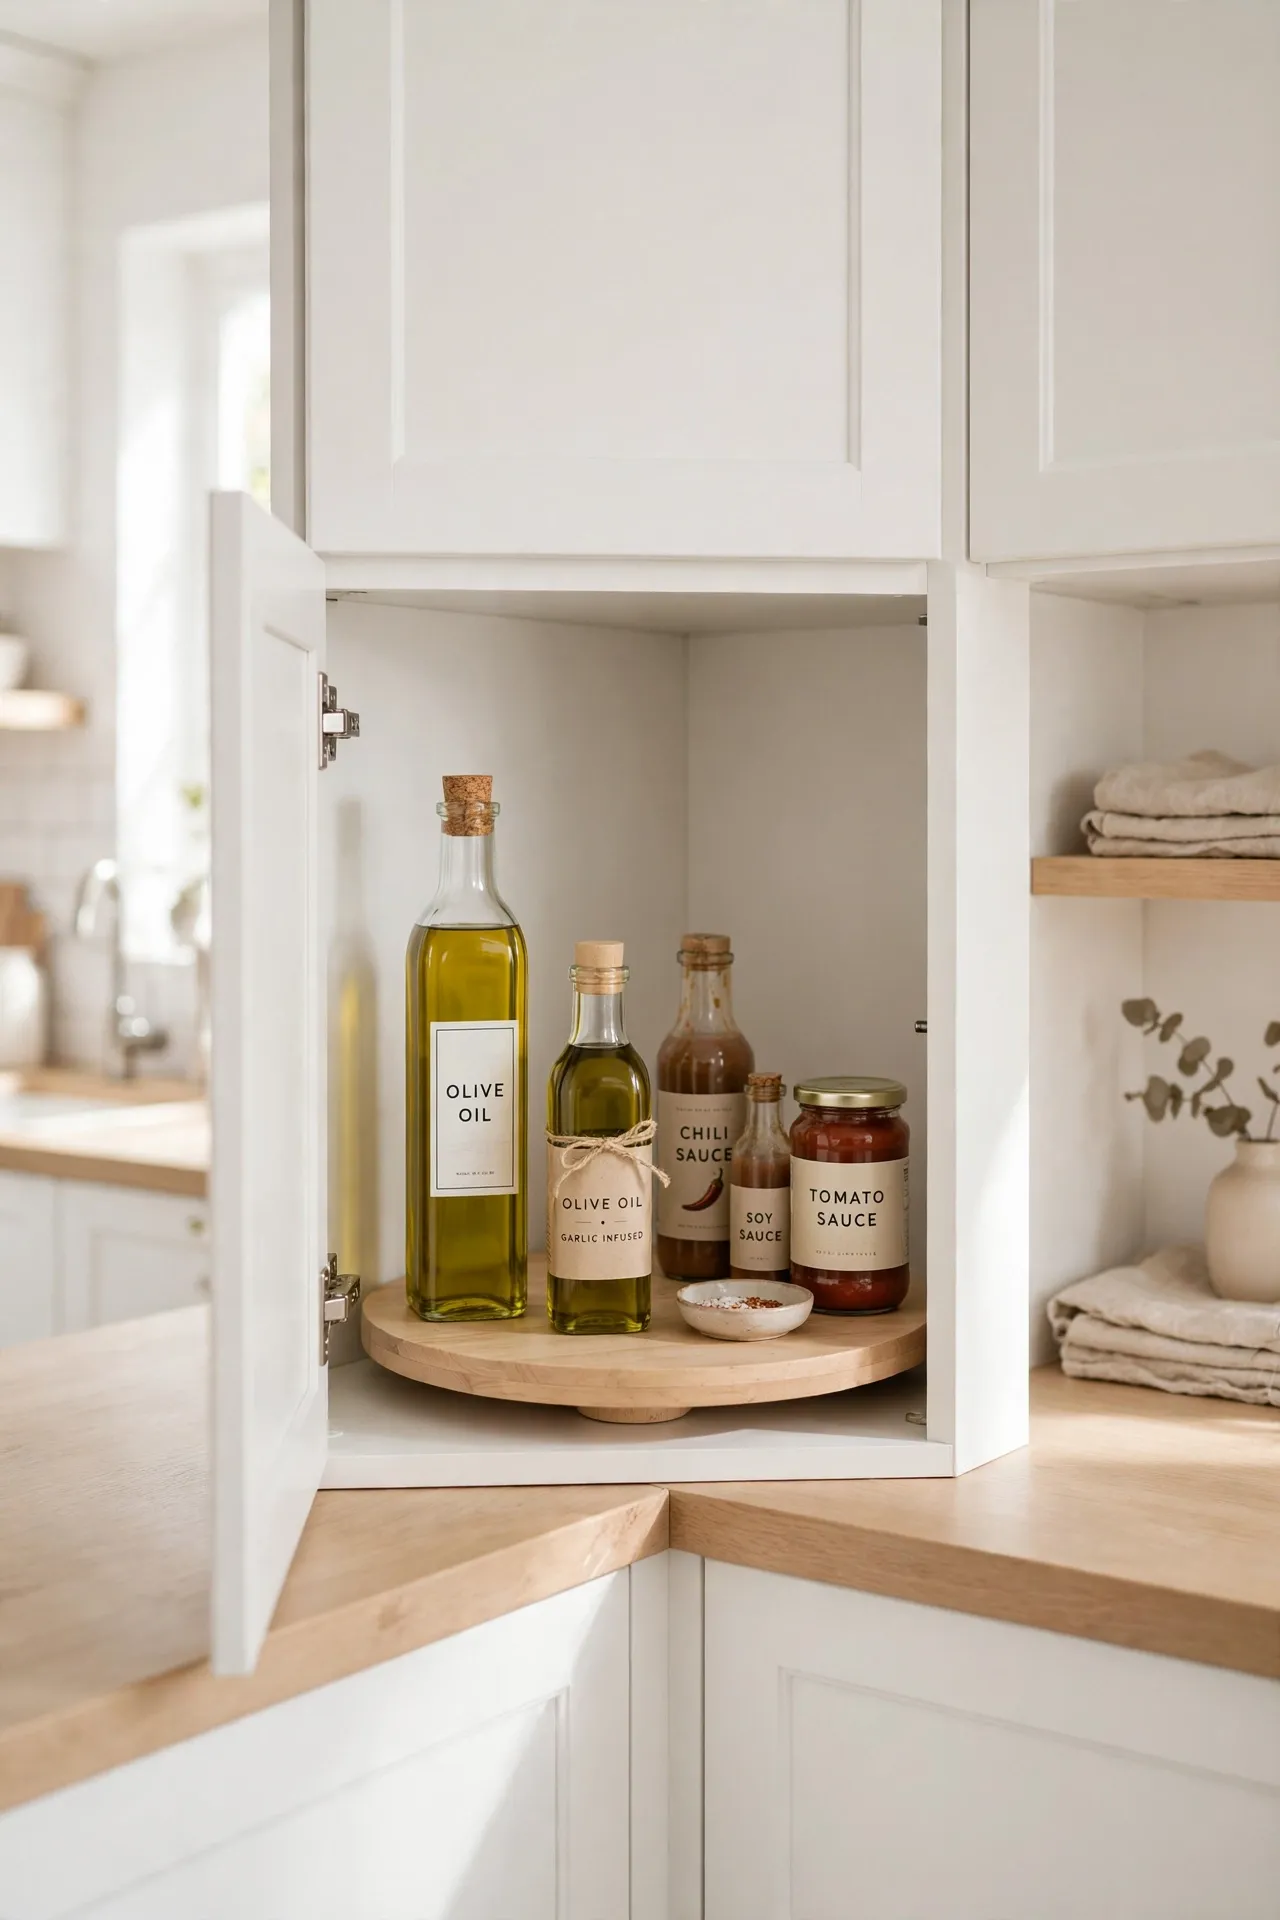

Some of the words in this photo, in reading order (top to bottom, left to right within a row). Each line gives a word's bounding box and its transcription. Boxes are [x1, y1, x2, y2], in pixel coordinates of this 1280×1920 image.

[446, 1083, 504, 1099] OLIVE
[458, 1108, 492, 1123] OIL
[680, 1126, 728, 1141] CHILI
[676, 1147, 732, 1163] SAUCE
[562, 1197, 610, 1211] OLIVE
[617, 1196, 643, 1209] OIL
[809, 1188, 885, 1205] TOMATO
[746, 1212, 773, 1225] SOY
[816, 1211, 877, 1228] SAUCE
[561, 1233, 598, 1243] GARLIC
[602, 1230, 644, 1243] INFUSED
[739, 1229, 783, 1242] SAUCE
